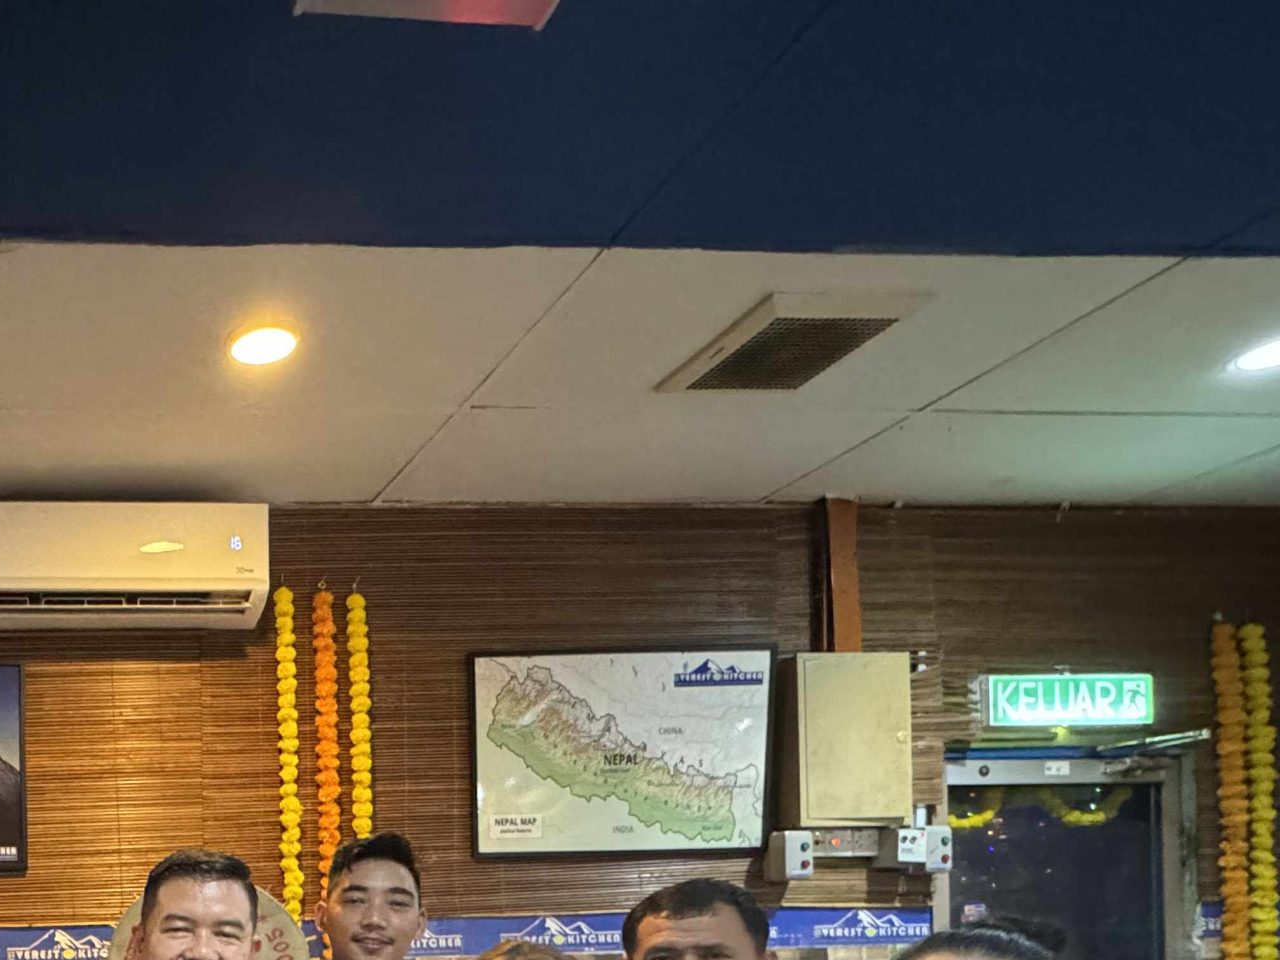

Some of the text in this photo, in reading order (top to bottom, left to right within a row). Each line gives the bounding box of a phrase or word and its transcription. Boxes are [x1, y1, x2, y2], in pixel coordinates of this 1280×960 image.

[996, 679, 1118, 721] KELUAR
[659, 727, 683, 736] CHINA
[604, 754, 639, 766] NEPAL
[495, 817, 537, 826] NEPAL MAP
[612, 825, 634, 834] INDIA
[879, 926, 928, 937] KITCHEN
[569, 933, 620, 944] KITCHEN
[78, 948, 108, 960] KITC
